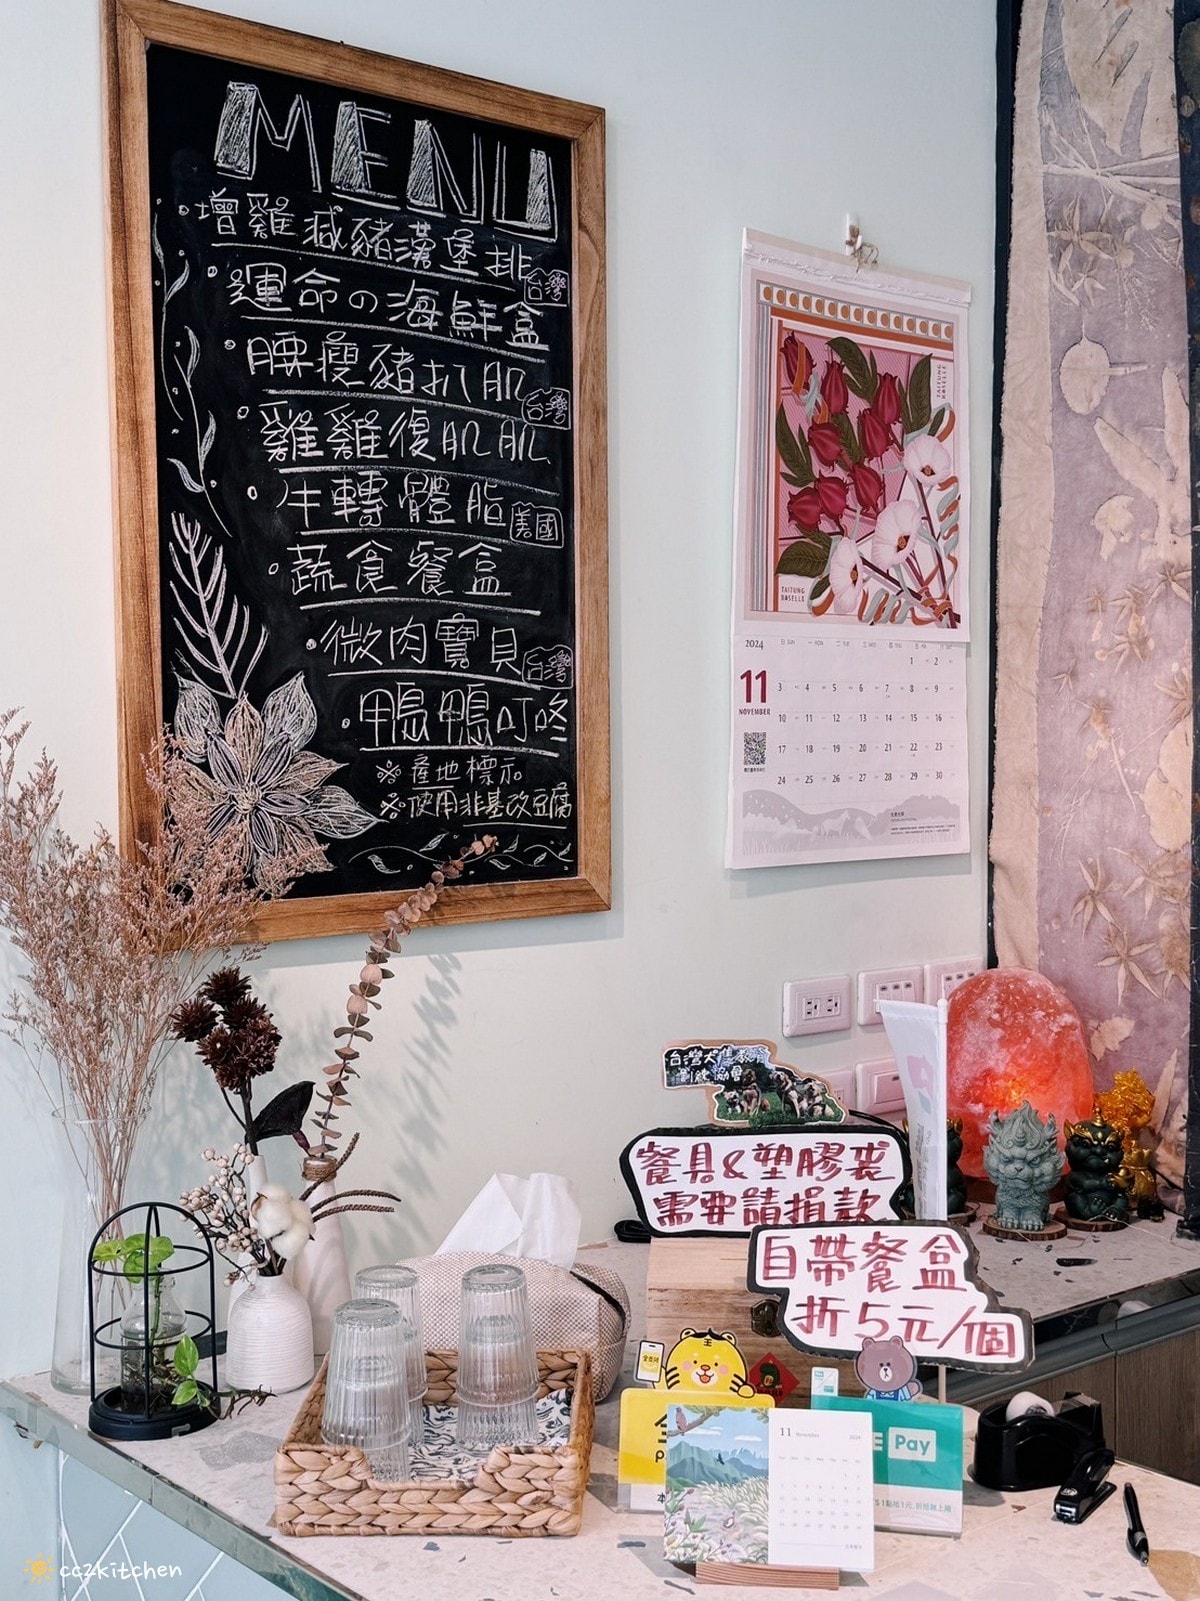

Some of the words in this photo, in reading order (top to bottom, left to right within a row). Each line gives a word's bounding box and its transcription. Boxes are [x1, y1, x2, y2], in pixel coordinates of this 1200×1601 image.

[214, 81, 558, 241] MENU
[228, 261, 549, 351] 運命の海鮮盒
[513, 508, 559, 542] 美國
[287, 540, 511, 597] 蔬食餐盒
[781, 586, 805, 594] TAITUNG
[320, 613, 521, 674] 微肉寶貝
[746, 640, 763, 649] 2024
[933, 657, 939, 665] 2
[740, 670, 767, 703] 11
[777, 683, 783, 691] 3
[832, 684, 837, 692] 5
[858, 684, 864, 692] 6
[884, 684, 890, 692] 7
[738, 707, 771, 716] NOVEMBER
[779, 714, 787, 722] 10
[806, 714, 813, 722] 11
[833, 714, 841, 722] 12
[860, 714, 868, 722] 13
[779, 745, 787, 753] 17
[806, 745, 814, 753] 18
[833, 744, 841, 752] 19
[859, 744, 867, 752] 20
[910, 743, 918, 751] 22
[935, 743, 943, 751] 23
[778, 776, 786, 785] 24
[805, 775, 814, 783] 25
[832, 774, 841, 782] 26
[859, 774, 867, 782] 27
[885, 773, 893, 781] 28
[911, 772, 919, 780] 29
[936, 771, 943, 779] 30
[636, 1141, 896, 1186] 餐具&塑膠袋
[653, 1186, 886, 1226] 需要請捐款
[762, 1231, 967, 1293] 自帶餐盒
[791, 1296, 1016, 1357] 折5元/個
[780, 1427, 791, 1436] 11
[895, 1434, 930, 1456] Pay
